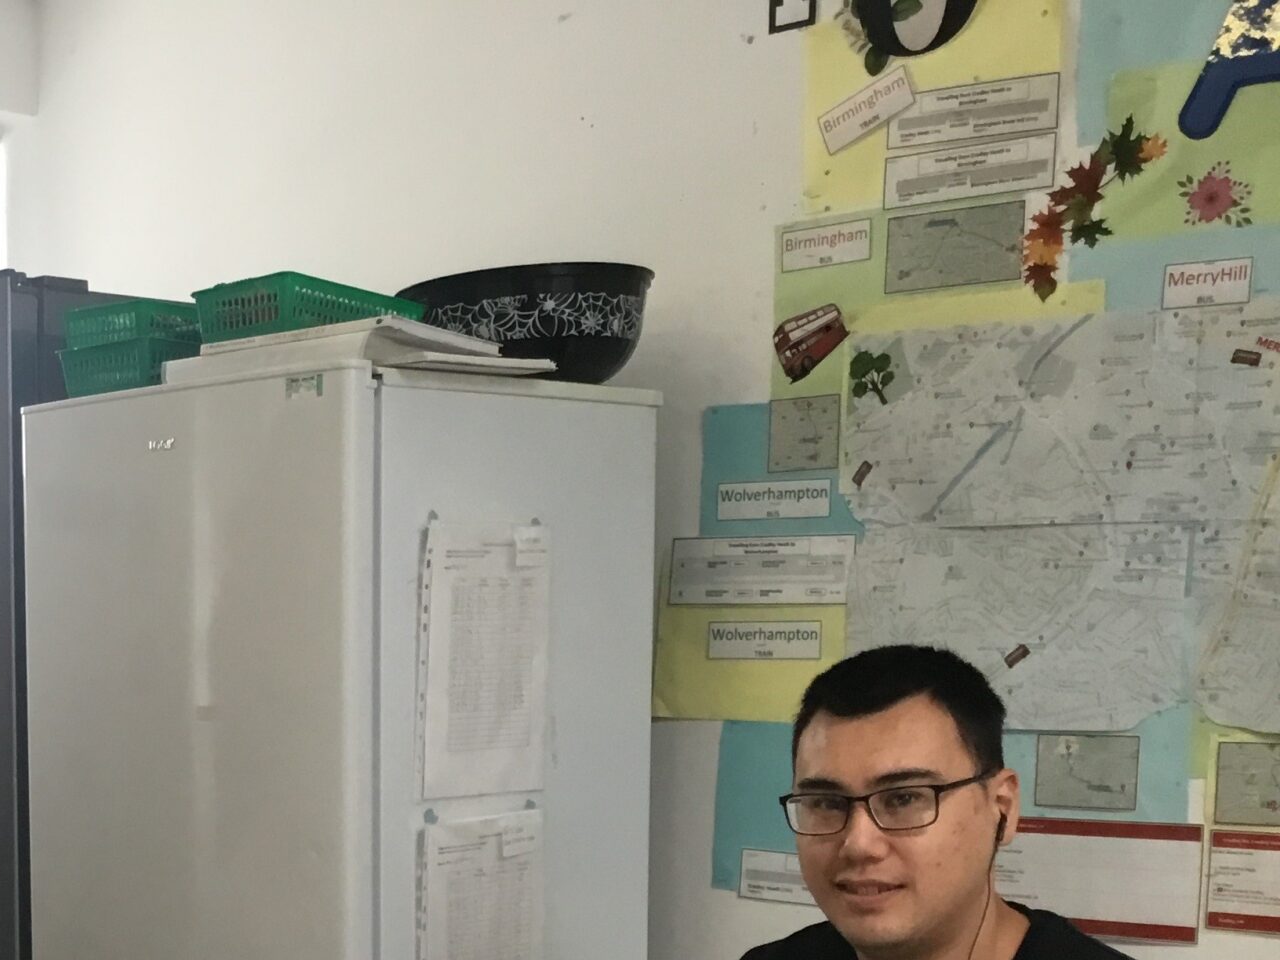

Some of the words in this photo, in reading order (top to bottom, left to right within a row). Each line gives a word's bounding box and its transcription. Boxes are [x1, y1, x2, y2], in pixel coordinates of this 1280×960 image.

[822, 76, 906, 134] Birmingham
[785, 228, 868, 252] Birmingham
[1168, 264, 1248, 288] MerryHill
[720, 487, 828, 503] Wolverhampton
[711, 627, 818, 643] Wolverhampton
